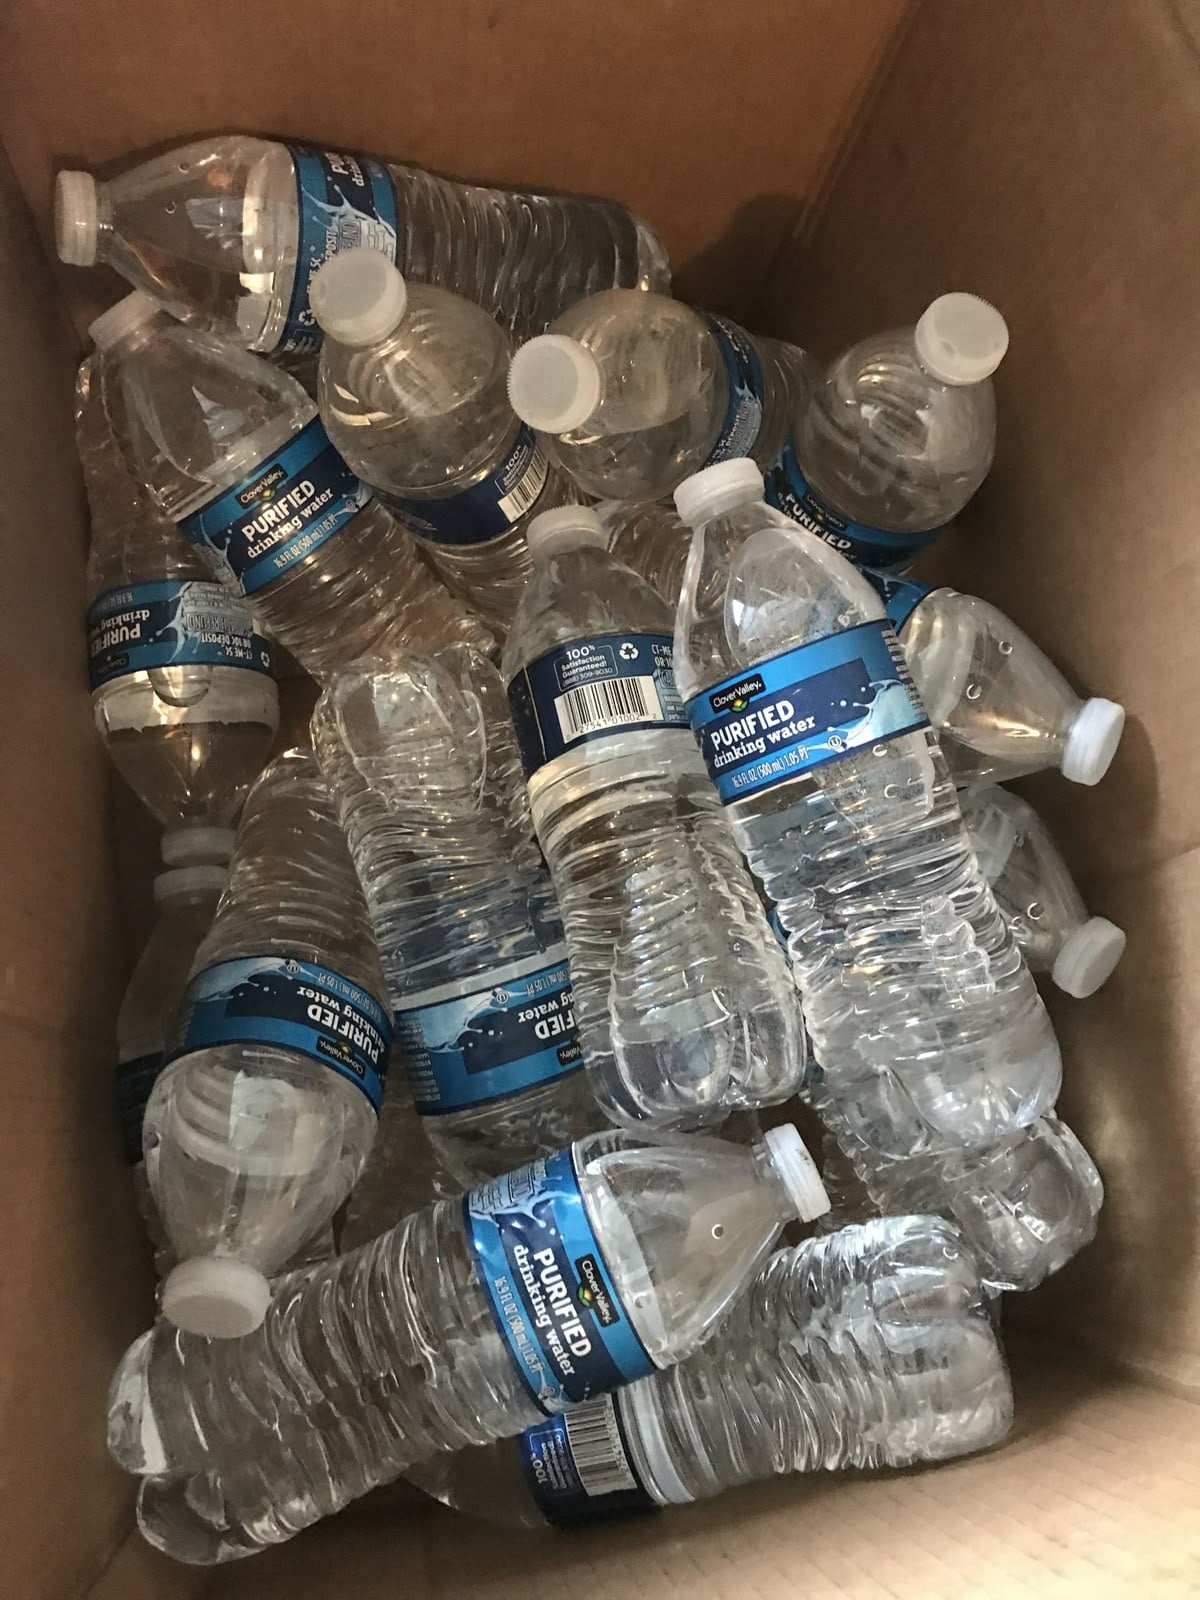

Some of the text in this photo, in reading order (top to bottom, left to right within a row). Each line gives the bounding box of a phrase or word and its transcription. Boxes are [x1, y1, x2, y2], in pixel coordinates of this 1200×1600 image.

[325, 232, 337, 260] EPOSIT
[242, 480, 316, 542] PURIFIED
[247, 488, 334, 558] drinking water
[786, 492, 851, 550] PURIFIED
[102, 609, 150, 630] drinking
[200, 632, 230, 644] DEPOSIT
[566, 644, 595, 660] 100%
[562, 655, 605, 672] Satisfaction
[562, 661, 607, 678] Guaranteed!
[710, 700, 794, 751] PURIFIED
[714, 716, 816, 768] drinking water
[756, 762, 771, 780] (500
[784, 752, 800, 767] 1.05
[296, 986, 340, 1012] water
[518, 1002, 558, 1024] water
[307, 1004, 380, 1064] PURIFIED
[534, 1008, 576, 1040] FIED
[514, 1244, 576, 1376] drinking water
[534, 1248, 592, 1357] PURIFIED
